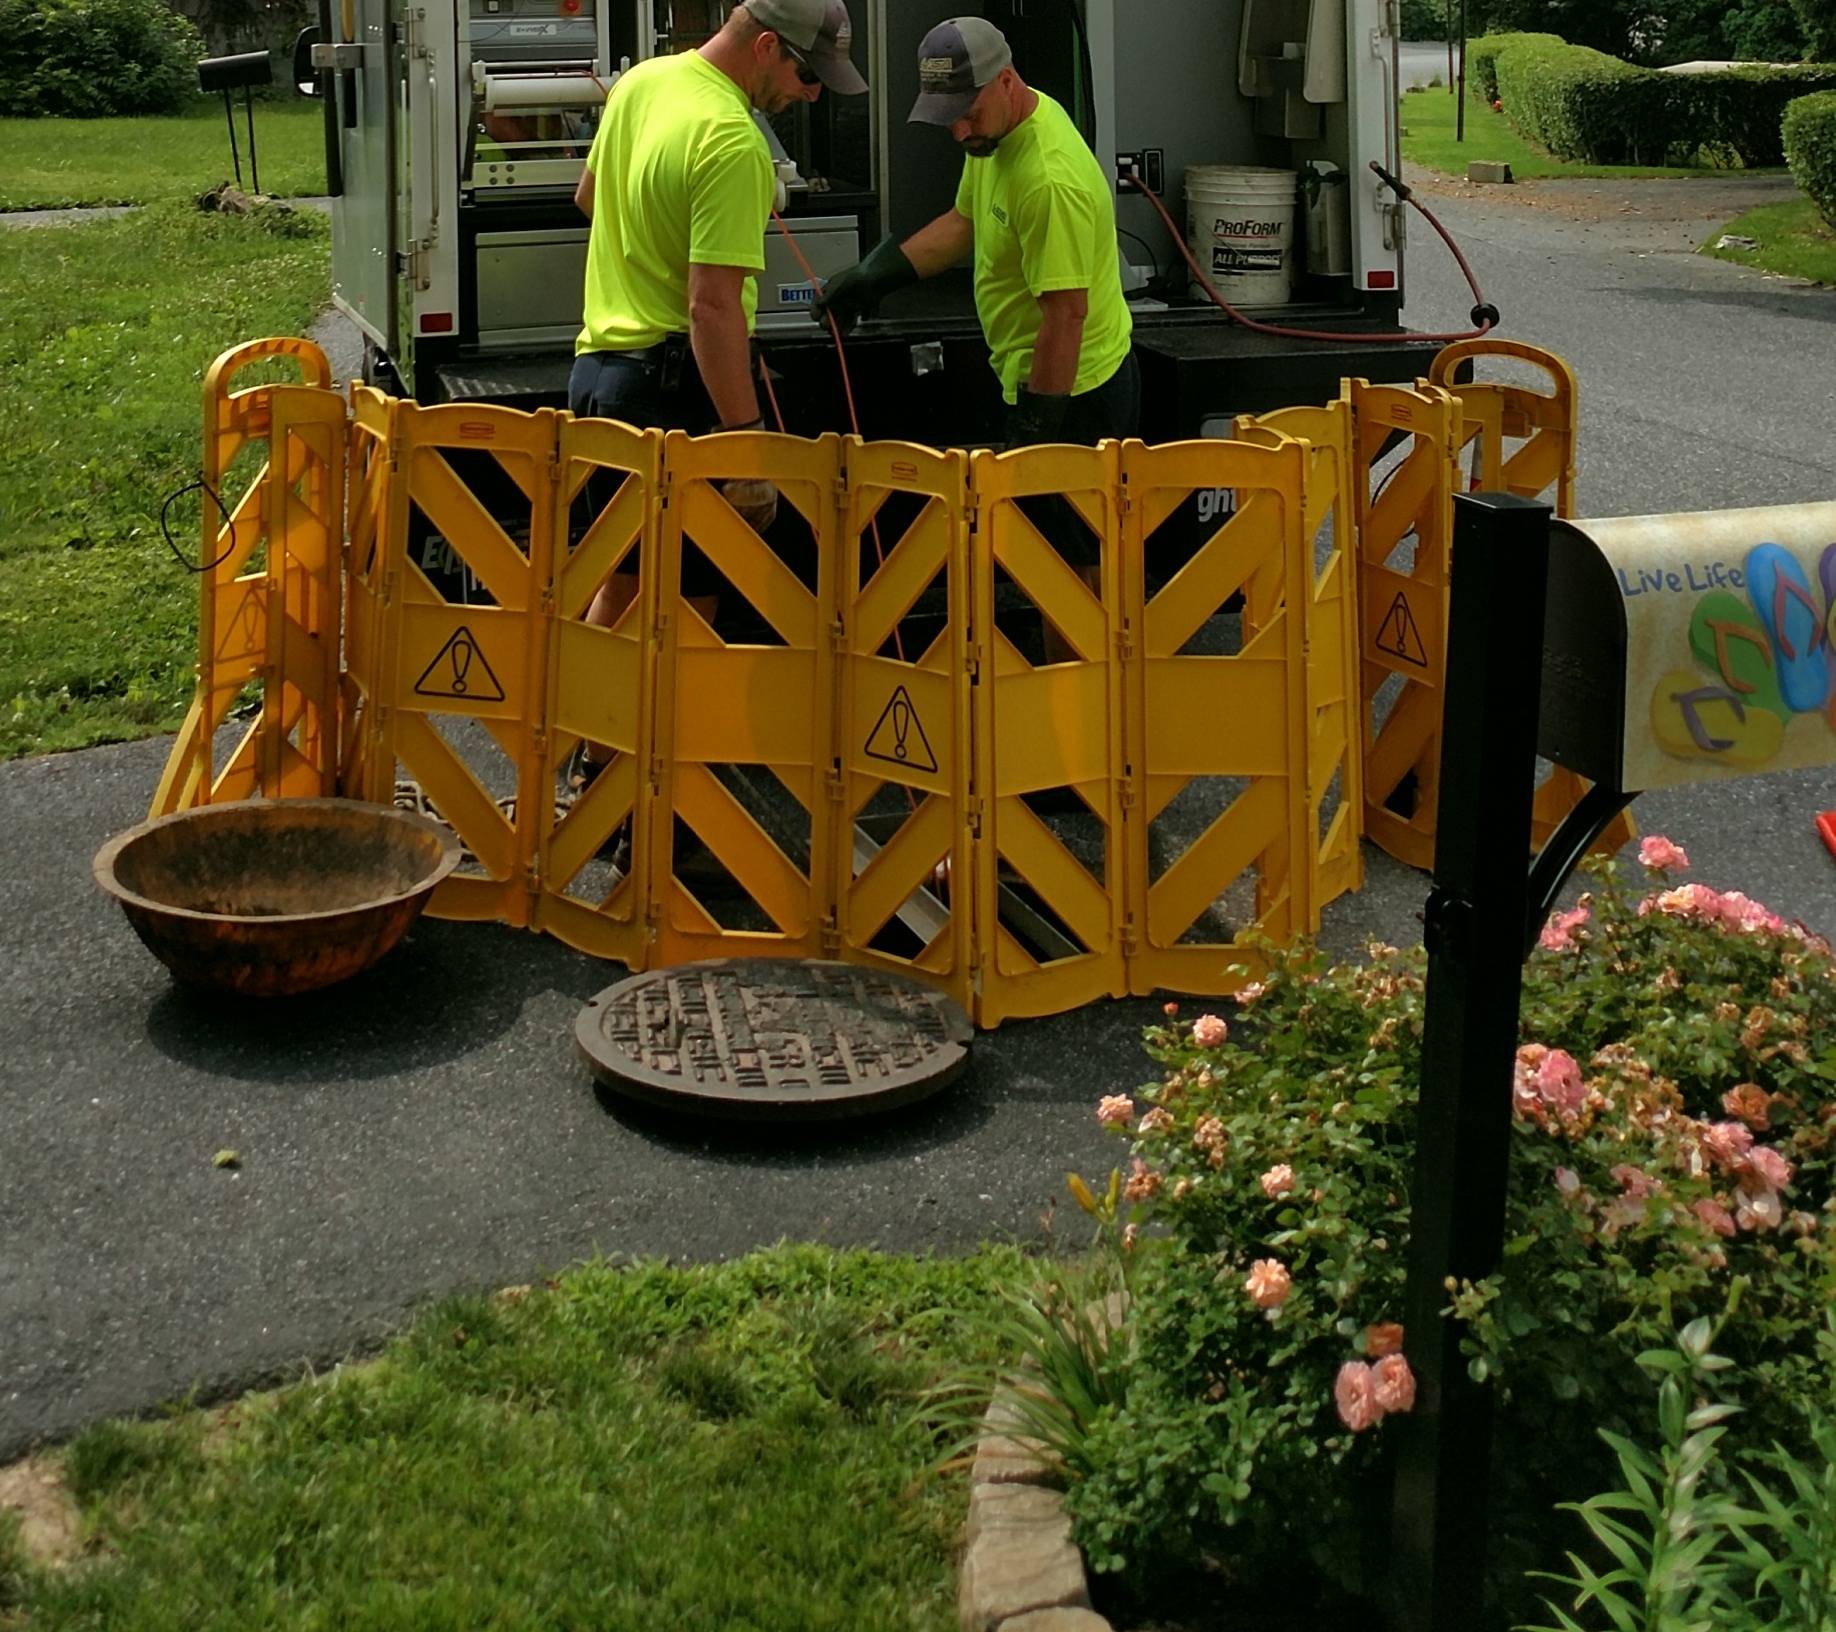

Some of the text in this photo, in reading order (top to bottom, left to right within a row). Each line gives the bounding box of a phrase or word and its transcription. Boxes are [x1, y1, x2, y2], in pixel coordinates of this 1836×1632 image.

[1214, 253, 1233, 264] ALL
[781, 288, 818, 302] BETTE
[1617, 562, 1746, 597] Live Life
